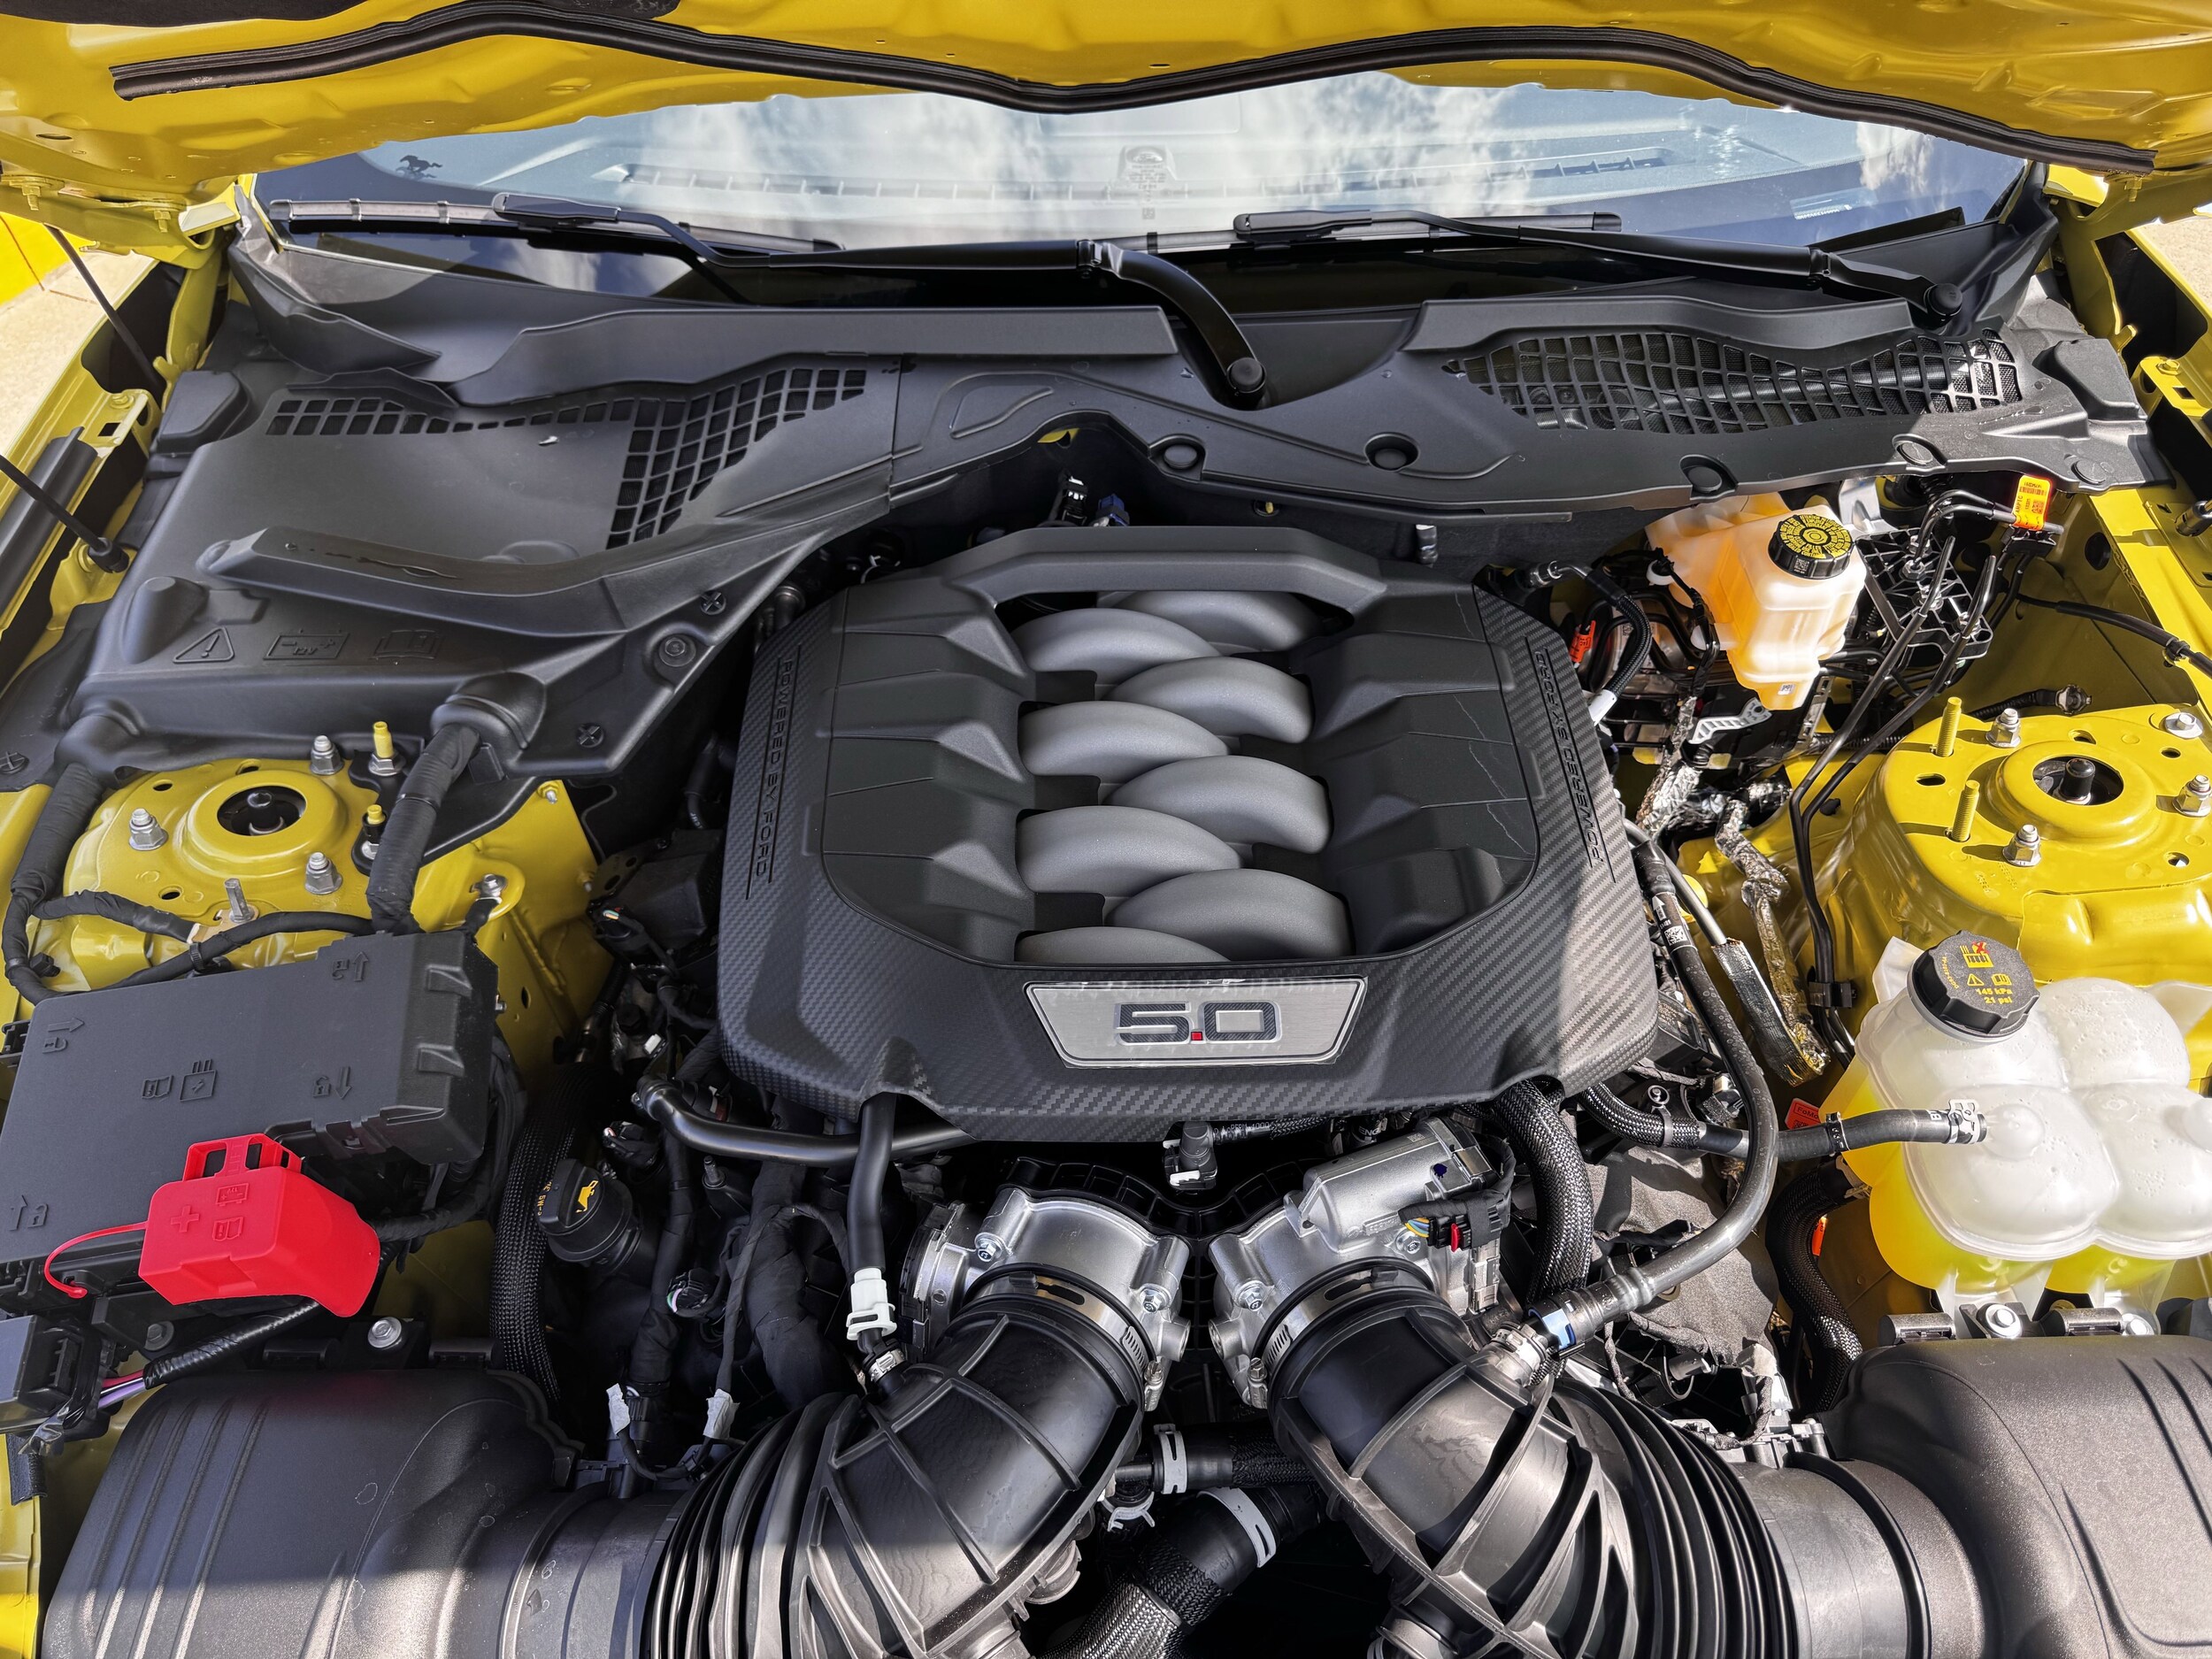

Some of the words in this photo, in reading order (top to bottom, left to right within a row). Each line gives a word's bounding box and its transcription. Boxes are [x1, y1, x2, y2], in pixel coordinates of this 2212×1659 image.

[1535, 651, 1558, 706] FORD
[771, 659, 792, 764] POWERED
[1552, 710, 1568, 741] BY
[766, 771, 779, 800] BY
[1563, 747, 1603, 863] POWERED
[757, 808, 774, 876] FORD
[1115, 1001, 1281, 1045] 5.0
[1797, 1106, 1818, 1119] FoMo
